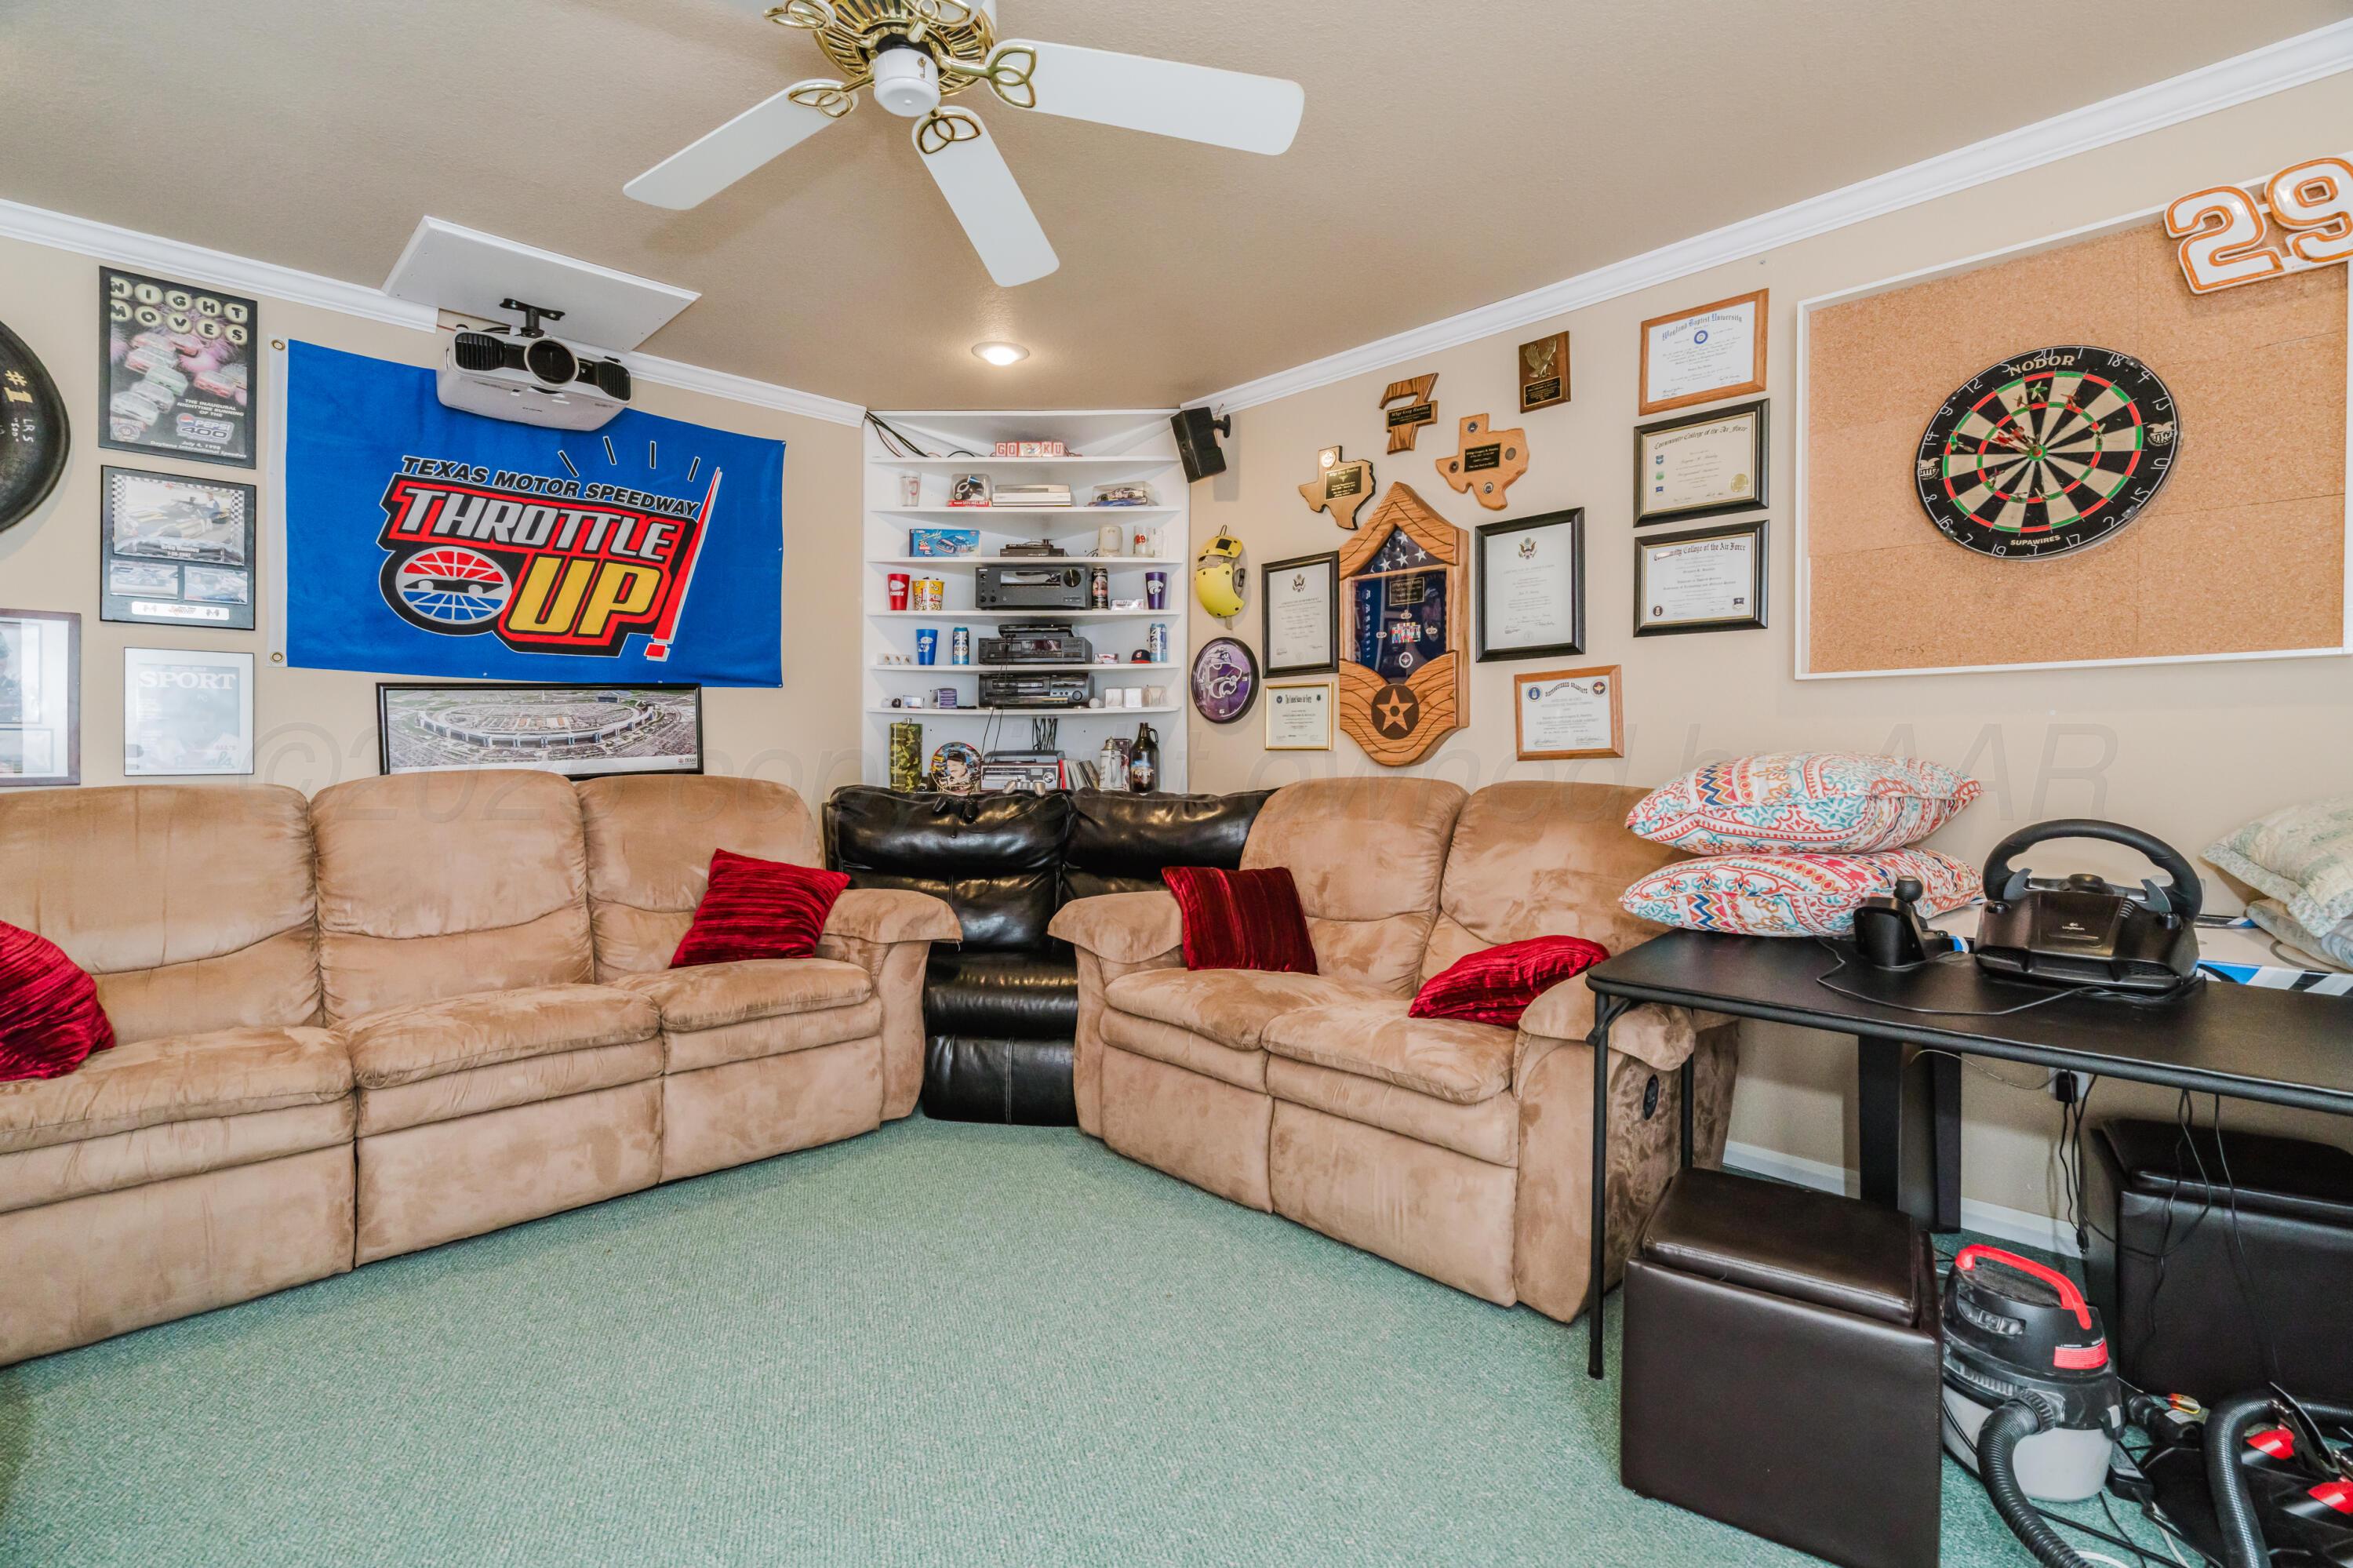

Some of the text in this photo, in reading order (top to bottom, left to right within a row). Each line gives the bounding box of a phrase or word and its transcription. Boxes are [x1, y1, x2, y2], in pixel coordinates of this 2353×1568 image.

[2163, 157, 2353, 295] 29
[111, 280, 244, 319] NIGHT
[111, 303, 243, 341] MOVES
[1688, 317, 1710, 327] Baptist
[1711, 312, 1743, 323] University
[2033, 347, 2054, 362] 20
[2108, 352, 2123, 367] 18
[2009, 355, 2075, 377] NODOR
[1966, 377, 1984, 393] 12
[181, 426, 227, 438] 400
[195, 420, 232, 431] PEPSI
[401, 455, 700, 517] TEXAS MOTOR SPEEDWAY
[400, 486, 677, 562] THROTTLE
[2009, 534, 2061, 547] SUPAWIRES
[1683, 544, 1703, 555] College
[138, 671, 236, 691] SPORT
